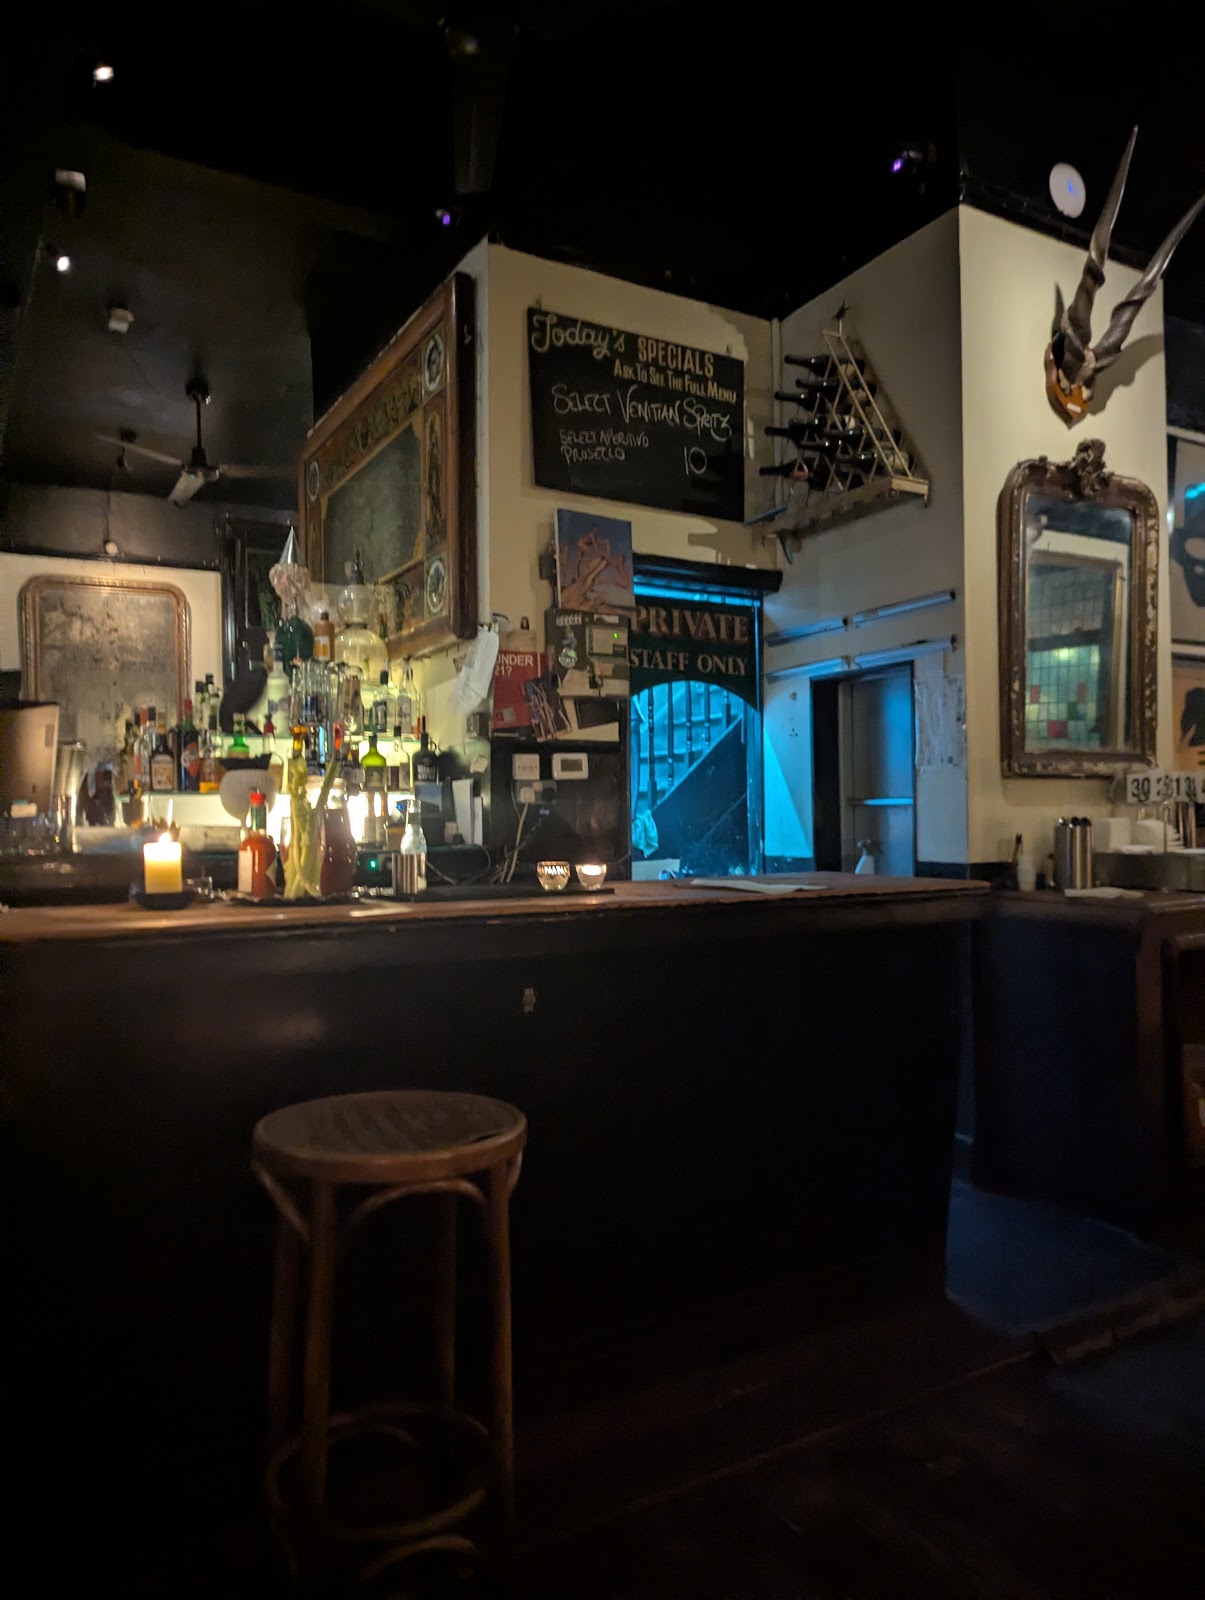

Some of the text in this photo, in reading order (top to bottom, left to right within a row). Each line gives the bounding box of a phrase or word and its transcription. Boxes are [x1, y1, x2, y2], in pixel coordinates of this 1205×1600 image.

[638, 336, 714, 378] SPECIALS
[551, 383, 611, 416] SELECT
[683, 397, 732, 442] SPRITZ
[561, 445, 626, 465] PROSECCO
[684, 447, 708, 475] 10
[630, 605, 749, 641] PRIVATE
[630, 648, 747, 676] STAFF ONLY
